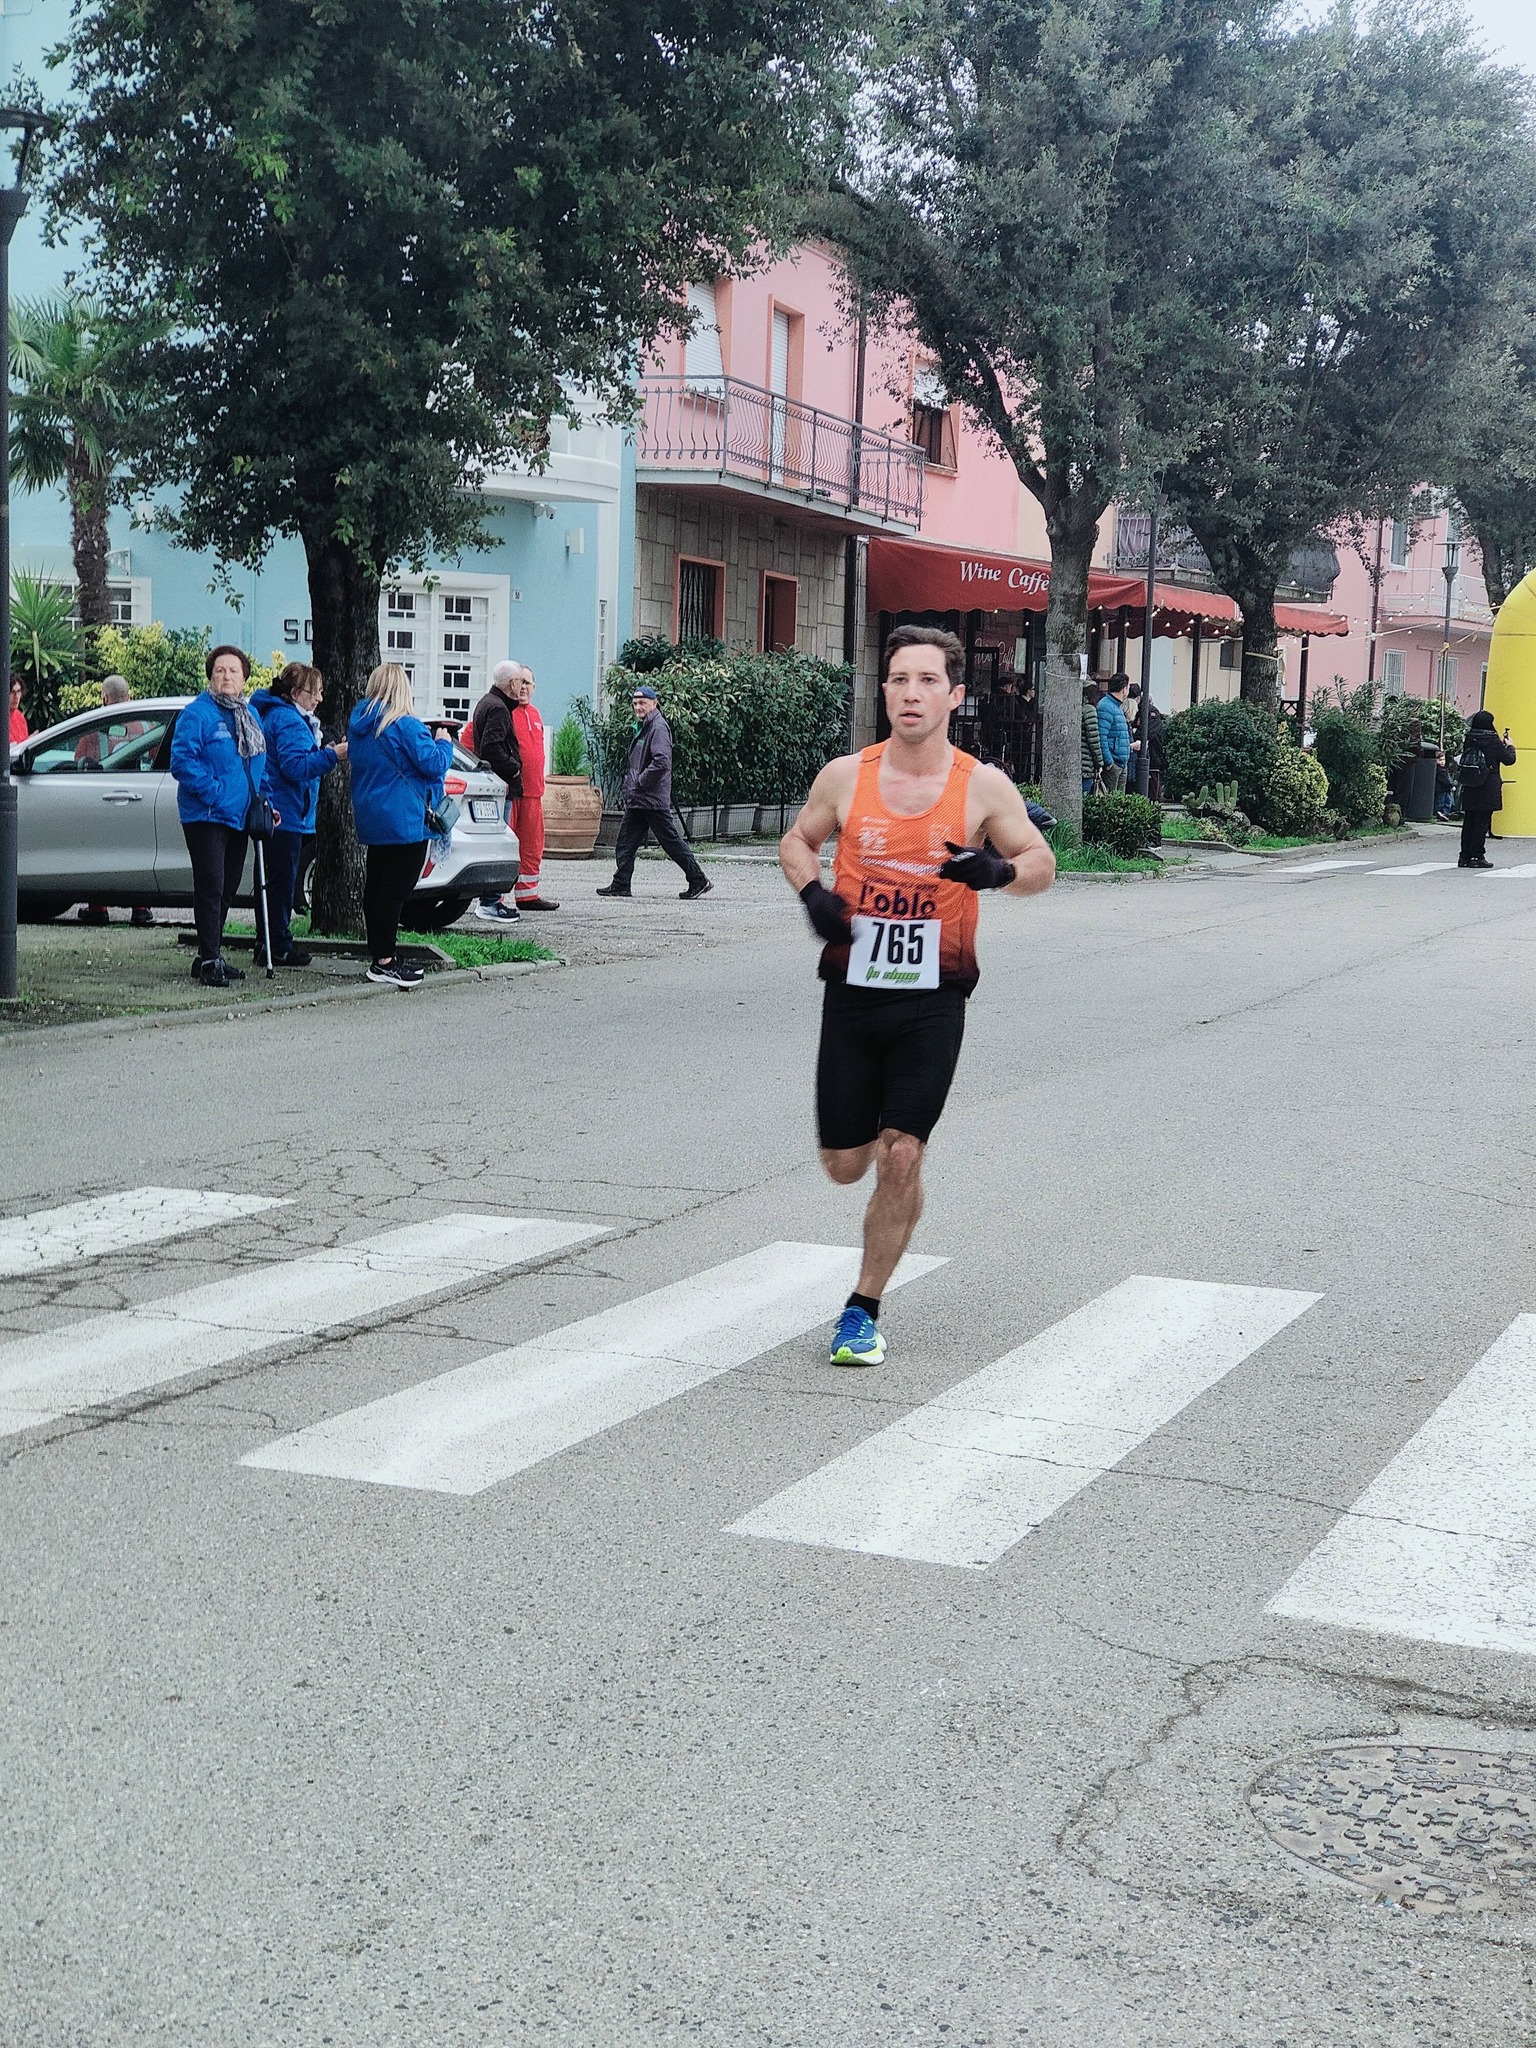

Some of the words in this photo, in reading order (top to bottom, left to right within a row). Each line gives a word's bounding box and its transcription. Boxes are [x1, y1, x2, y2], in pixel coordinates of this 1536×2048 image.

[960, 561, 1001, 582] Wine
[1008, 567, 1050, 595] Caffè
[869, 921, 925, 965] 765
